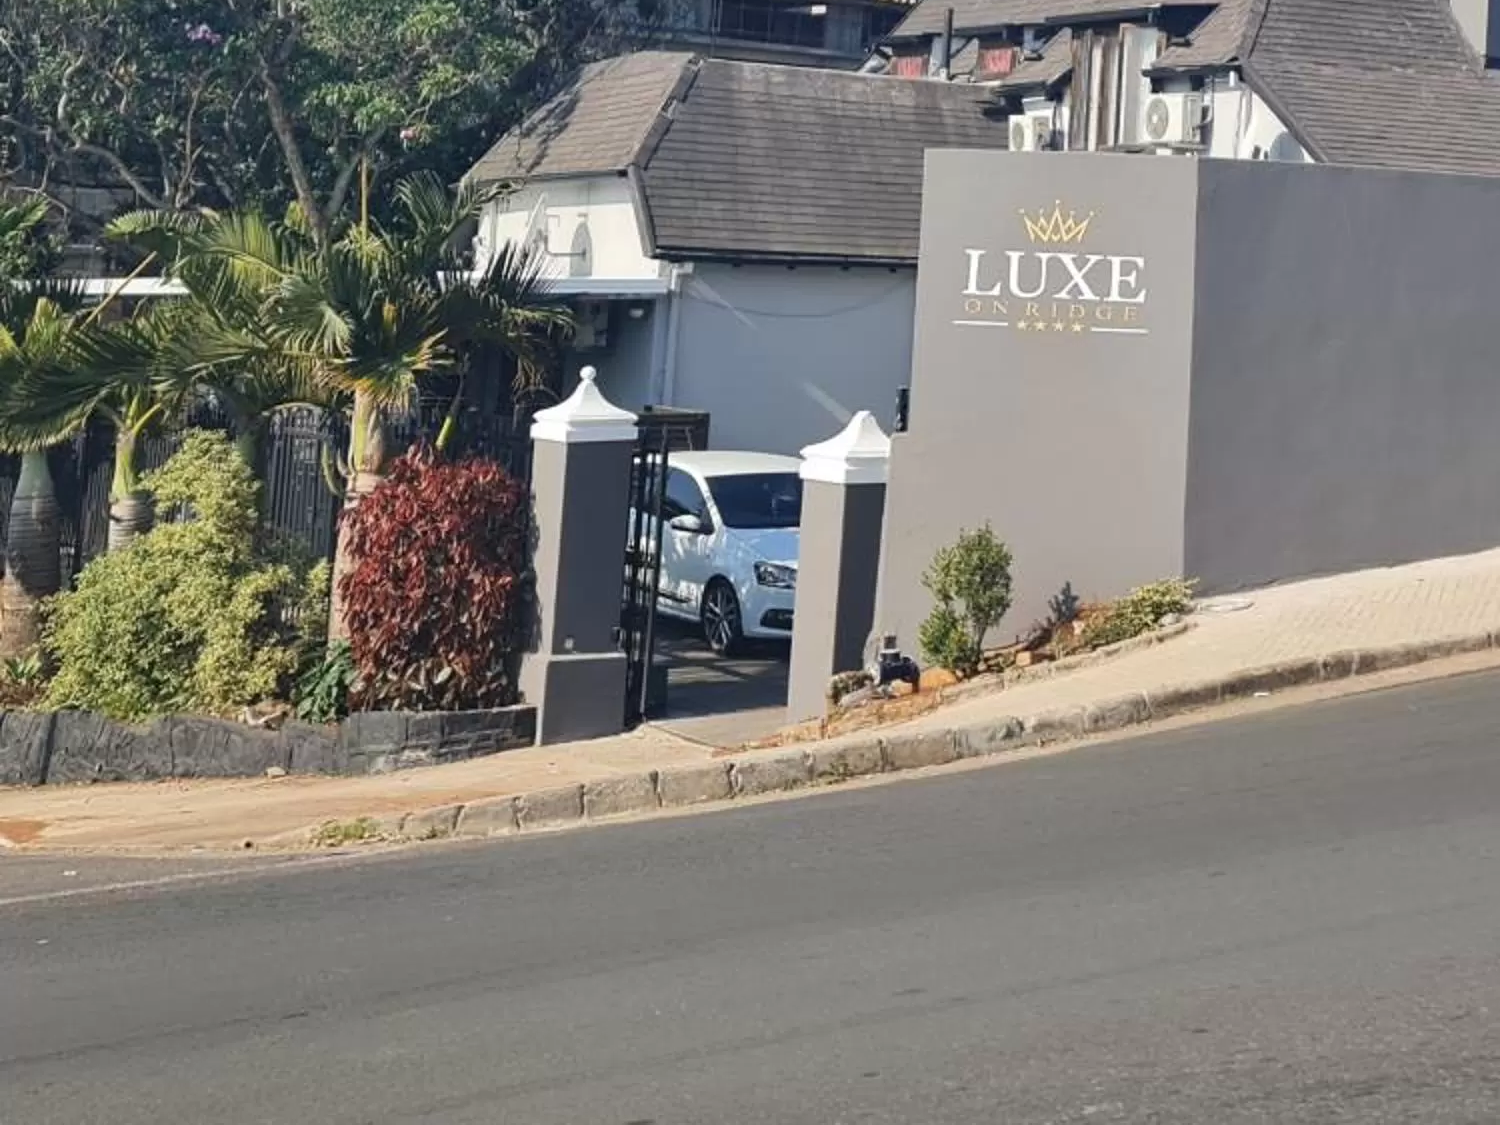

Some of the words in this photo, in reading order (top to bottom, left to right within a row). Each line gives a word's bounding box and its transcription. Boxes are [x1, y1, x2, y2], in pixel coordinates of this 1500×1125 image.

[961, 248, 1148, 304] LUXE
[963, 298, 1009, 315] ON
[1024, 301, 1138, 322] RIDGE
